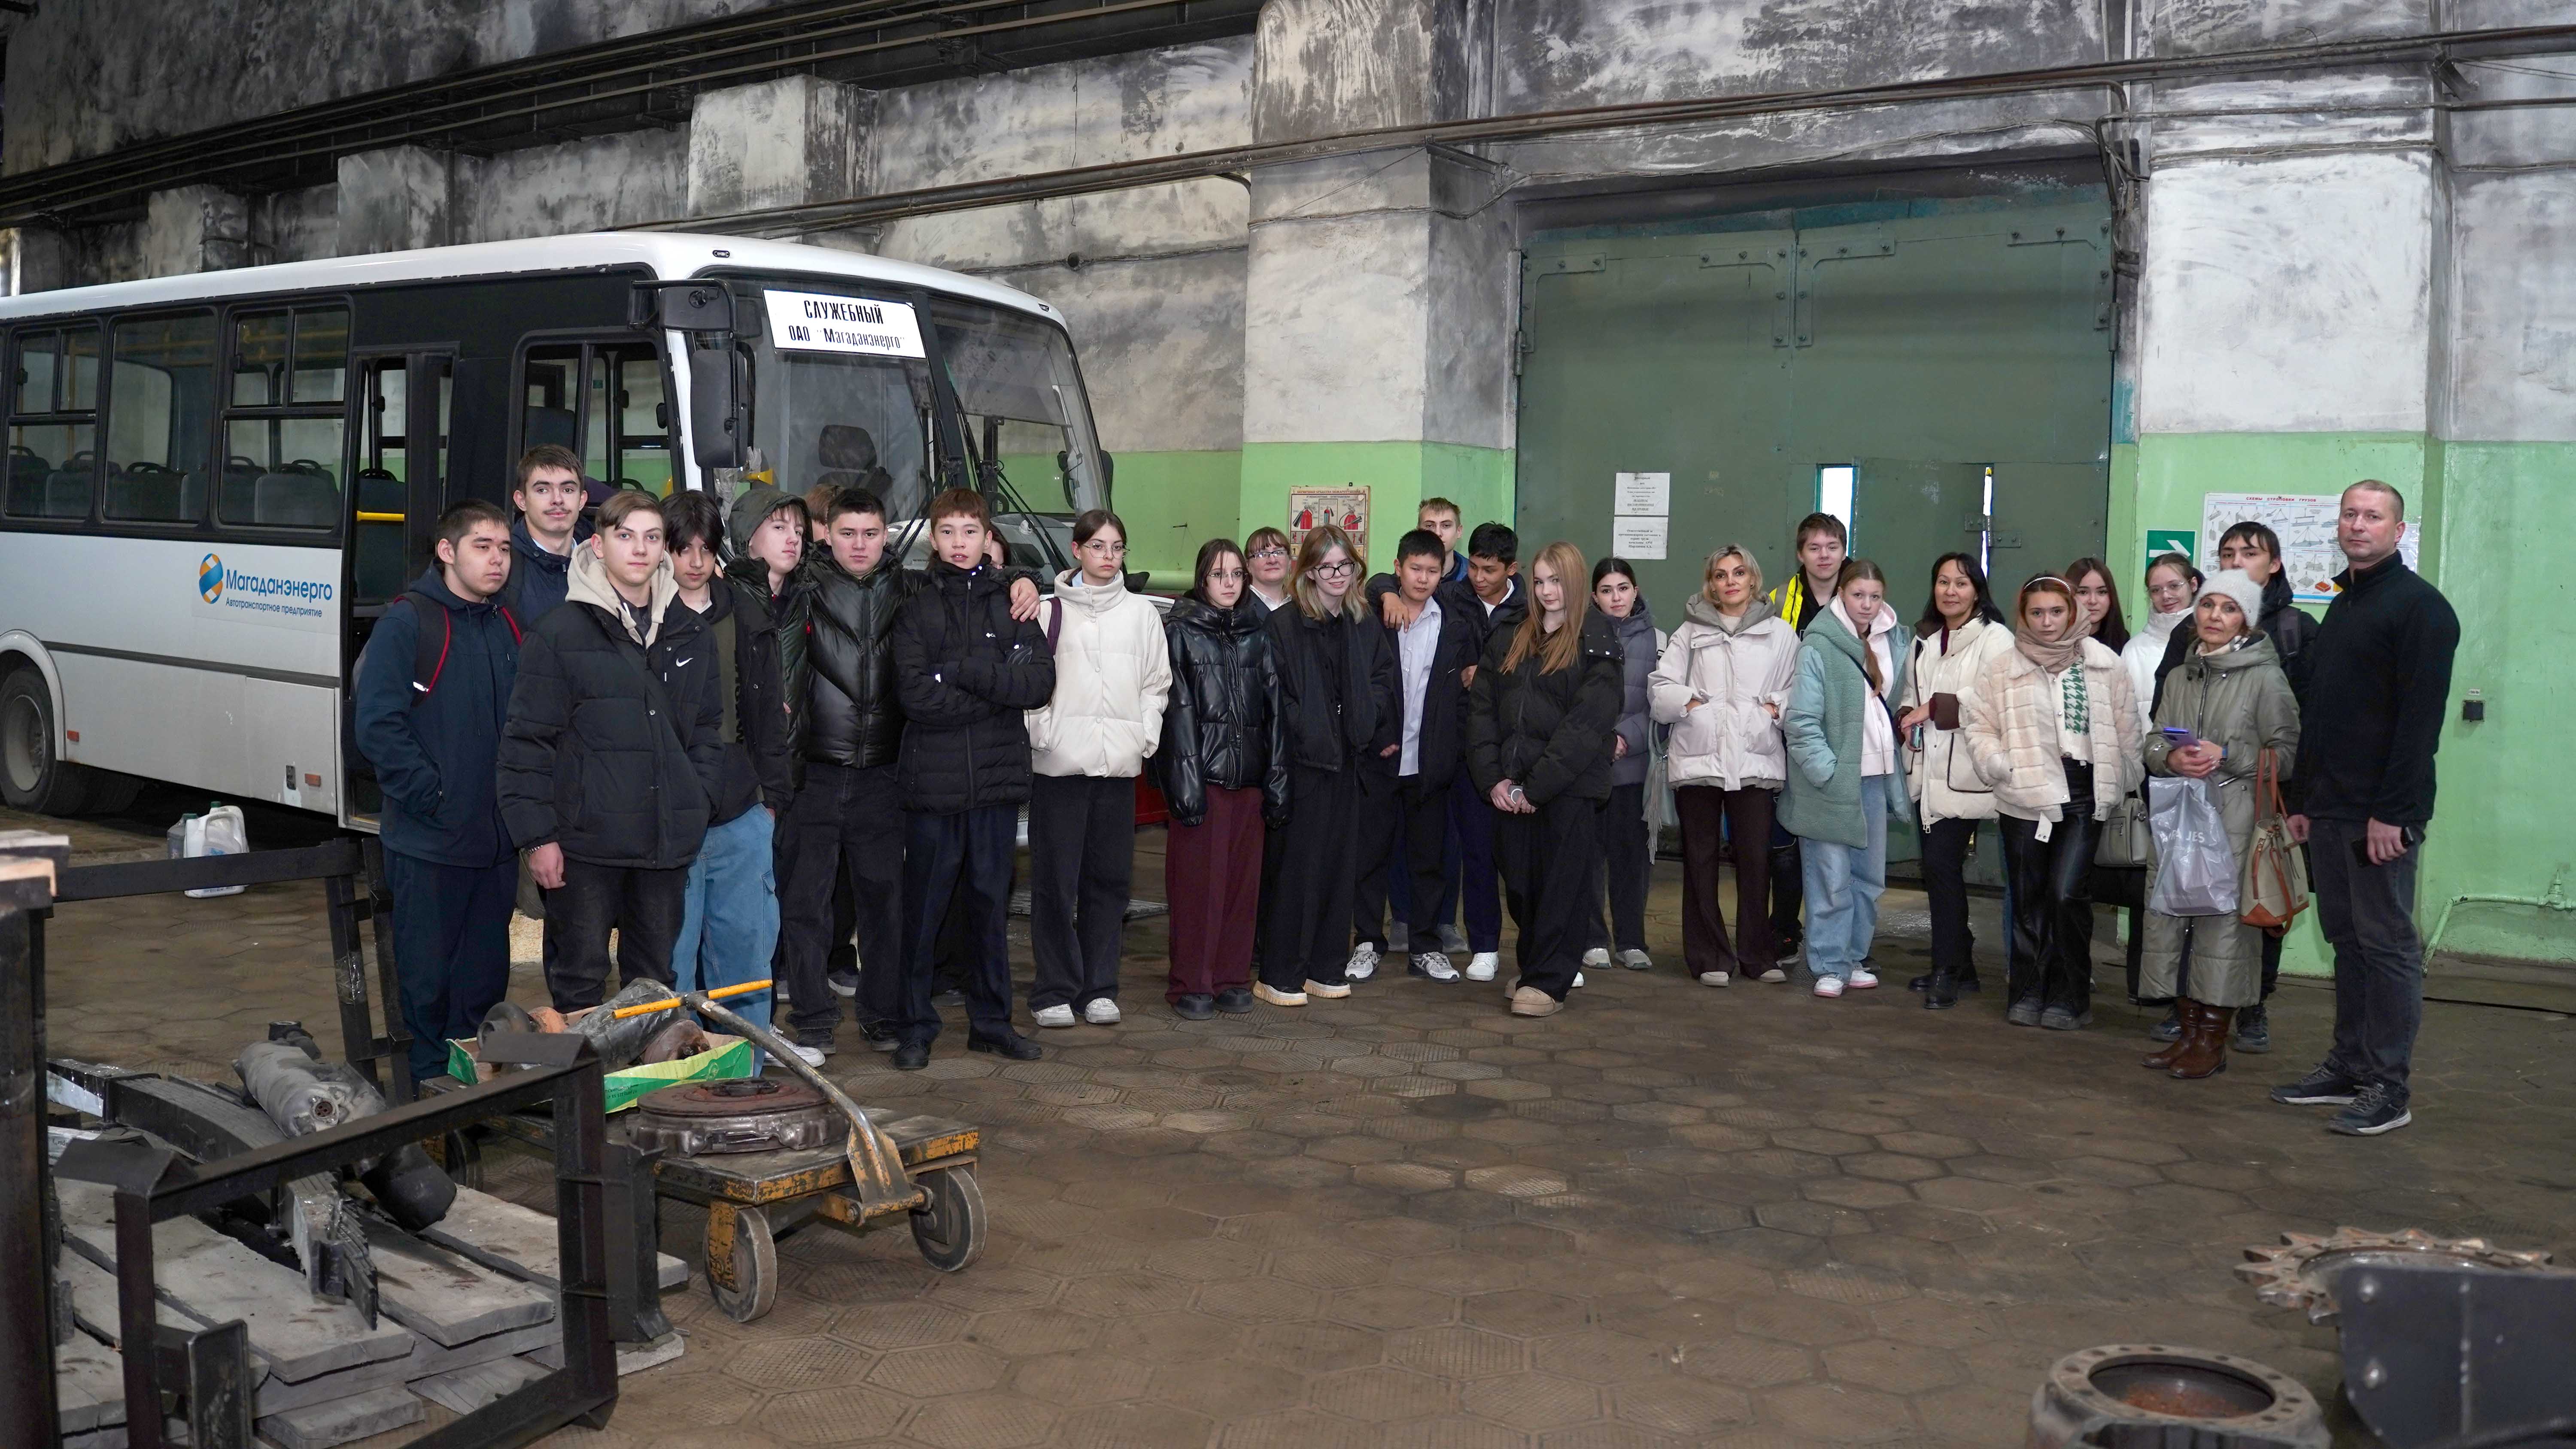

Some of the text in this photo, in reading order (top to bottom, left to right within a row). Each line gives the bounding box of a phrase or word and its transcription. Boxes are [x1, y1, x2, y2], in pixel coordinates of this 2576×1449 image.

[804, 300, 884, 324] СЛУЖЕБНЫЙ
[788, 325, 811, 342] ОАО
[226, 569, 332, 603] Магаданэнерго
[225, 597, 322, 617] Автотранспортное предприятие
[2185, 831, 2205, 843] JES
